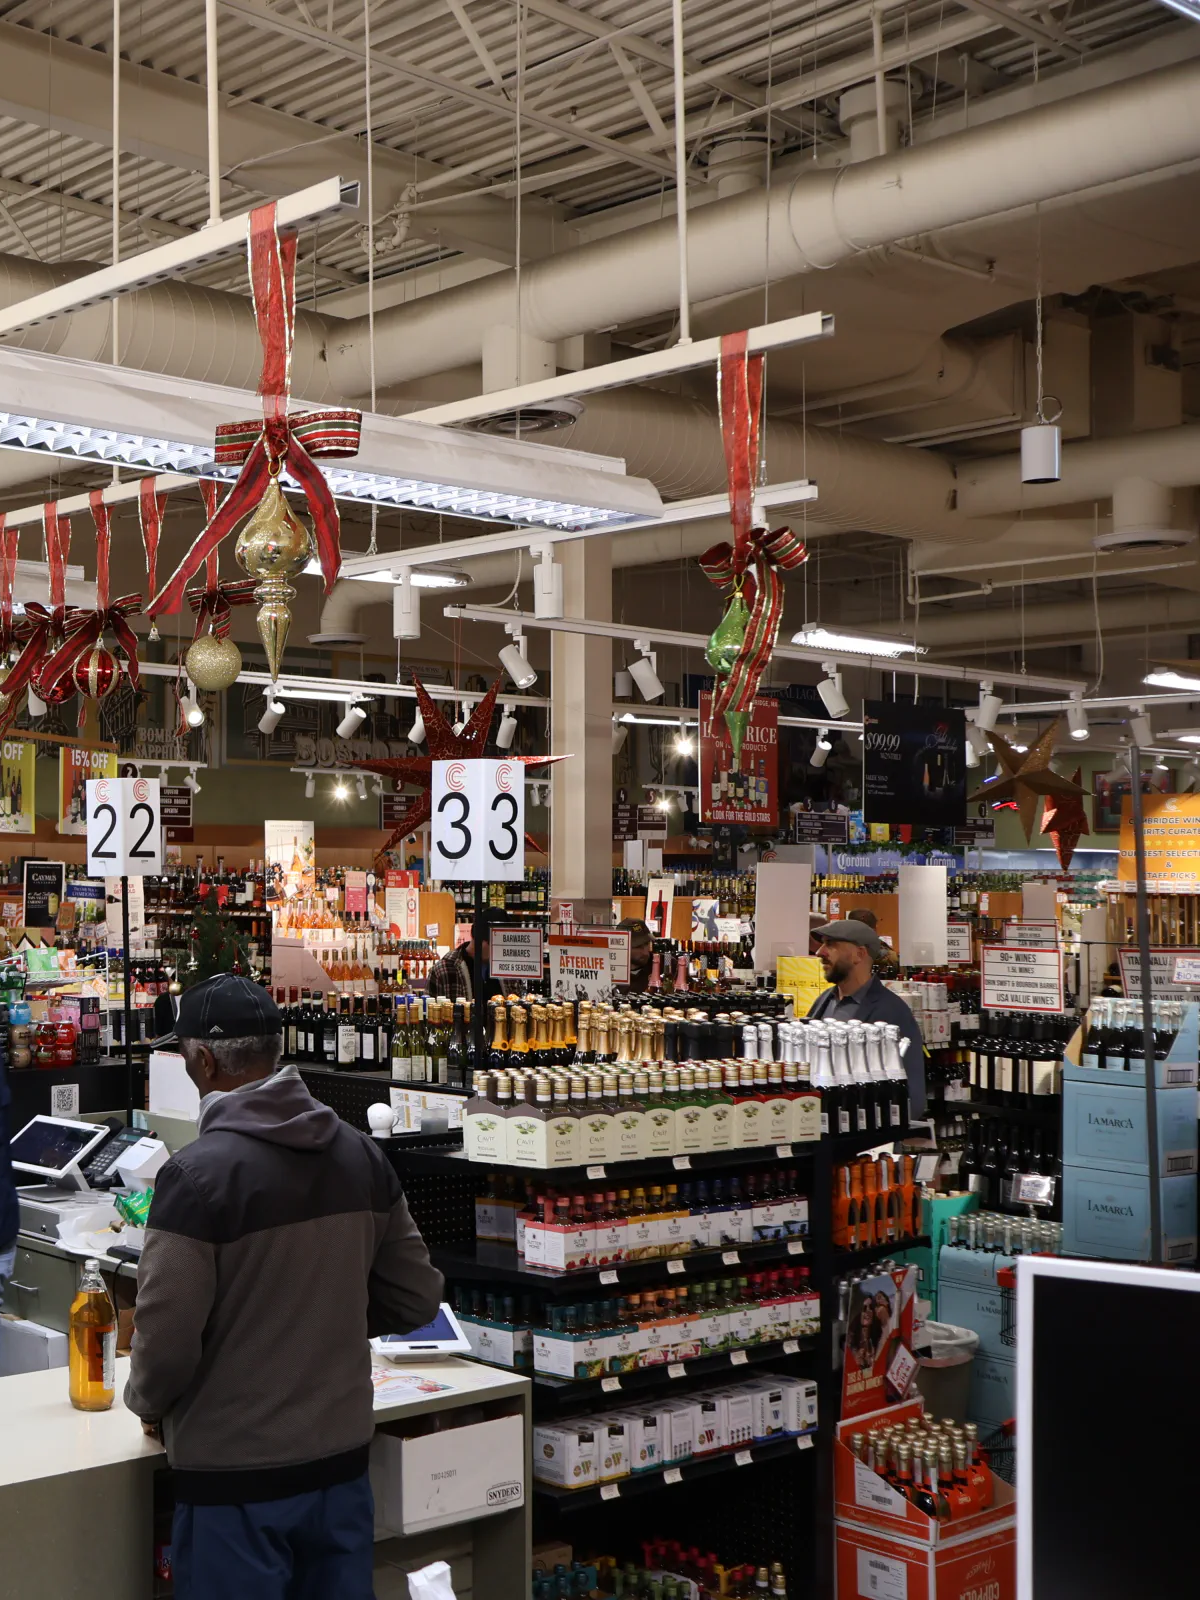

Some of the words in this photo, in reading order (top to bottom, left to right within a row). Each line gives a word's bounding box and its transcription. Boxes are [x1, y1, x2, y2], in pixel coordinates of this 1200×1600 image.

[746, 726, 777, 744] RICE
[742, 743, 767, 752] RODUCTS
[865, 732, 901, 752] $99.99
[3, 743, 24, 760] OFF
[71, 749, 90, 767] 15%
[91, 752, 109, 769] OFF
[713, 810, 725, 819] LOOK
[726, 811, 735, 820] FOR
[735, 812, 744, 821] THE
[745, 812, 756, 822] GOLD
[756, 813, 770, 822] STARS
[91, 803, 117, 858] 2
[129, 802, 156, 858] 2
[436, 792, 472, 859] 3
[489, 792, 519, 860] 3
[837, 852, 870, 870] Corona
[926, 853, 957, 869] Corona
[31, 873, 57, 882] CAYMUS
[561, 909, 572, 918] FIRE
[502, 934, 531, 944] BARWARES
[502, 949, 531, 958] BARWARES
[560, 948, 568, 956] THE
[1000, 952, 1013, 962] 90+
[1014, 953, 1037, 963] WINES
[499, 963, 510, 971] ROSE
[514, 964, 538, 972] SEASONAL
[559, 956, 605, 970] AFTERLIFE
[575, 970, 599, 980] PARTY
[996, 993, 1010, 1002] USA
[1010, 994, 1031, 1004] VALUE
[1032, 995, 1055, 1006] WINES
[488, 1485, 520, 1501] SNYDER'S
